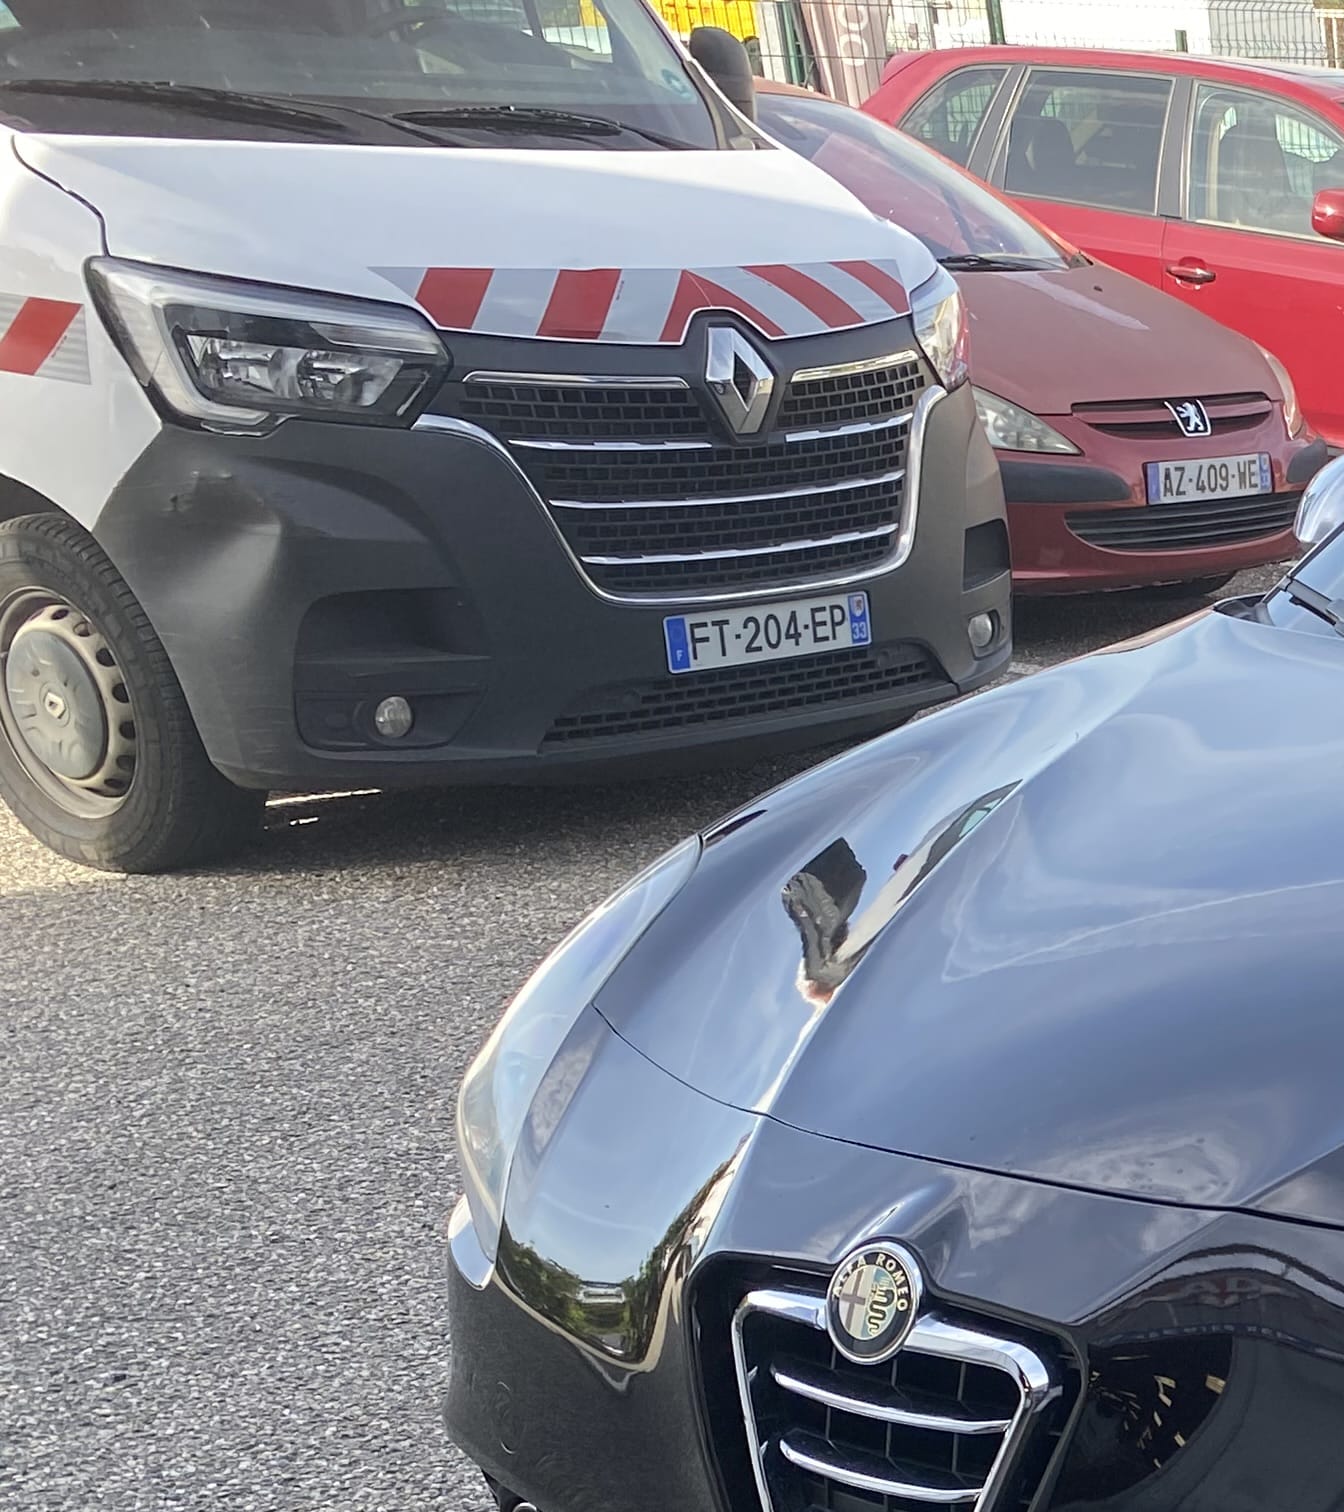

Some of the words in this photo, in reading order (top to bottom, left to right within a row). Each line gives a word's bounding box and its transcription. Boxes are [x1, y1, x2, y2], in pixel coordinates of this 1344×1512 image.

[1163, 459, 1258, 497] AZ-409-WE
[676, 650, 684, 661] F
[689, 604, 846, 660] FT-204-EP
[852, 622, 868, 639] 33
[876, 1253, 908, 1311] ROMEO
